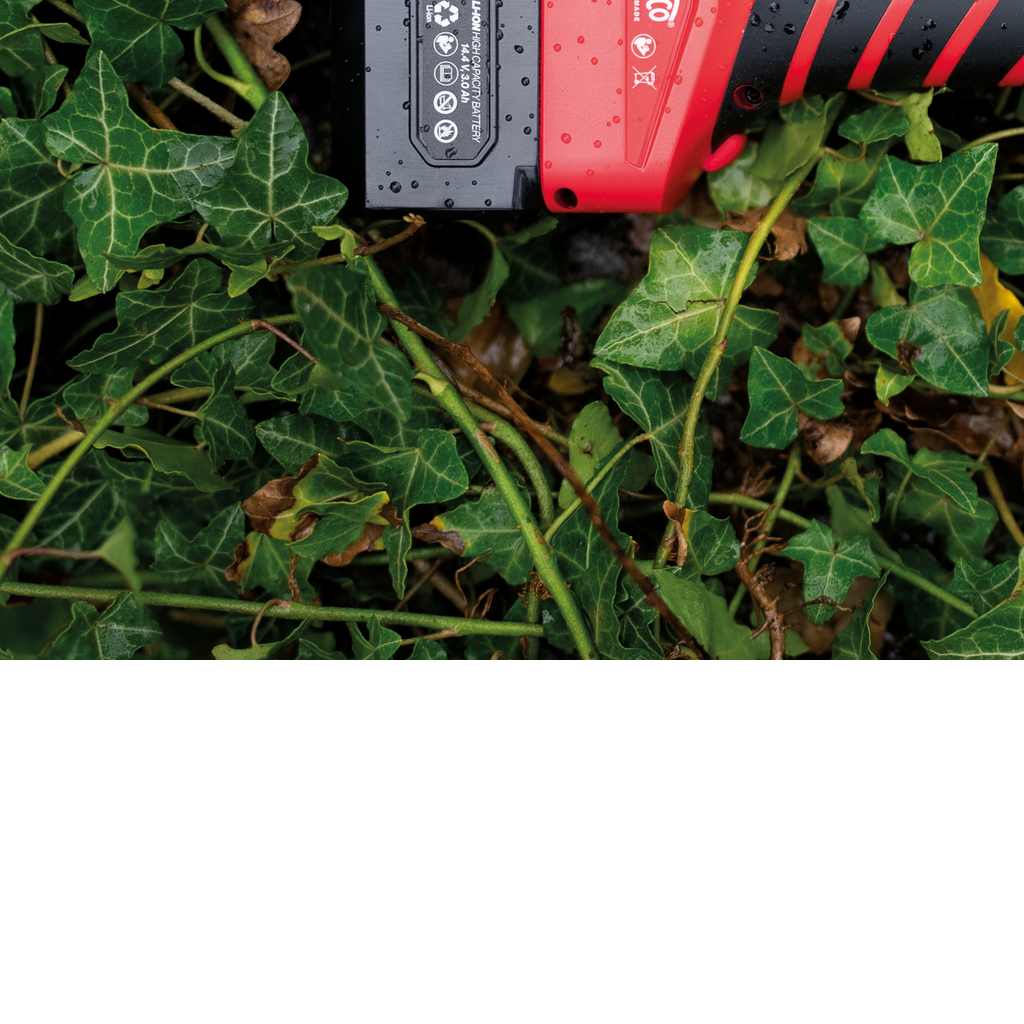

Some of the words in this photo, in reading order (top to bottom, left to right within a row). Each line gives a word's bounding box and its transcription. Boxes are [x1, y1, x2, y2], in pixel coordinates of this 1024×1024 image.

[471, 0, 481, 32] LI-ION
[461, 43, 470, 64] 14.4
[471, 30, 481, 57] HIGH
[461, 73, 470, 89] 3.0
[471, 56, 481, 102] CAPACITY
[461, 89, 470, 104] Ah
[471, 101, 481, 144] BATTERY
